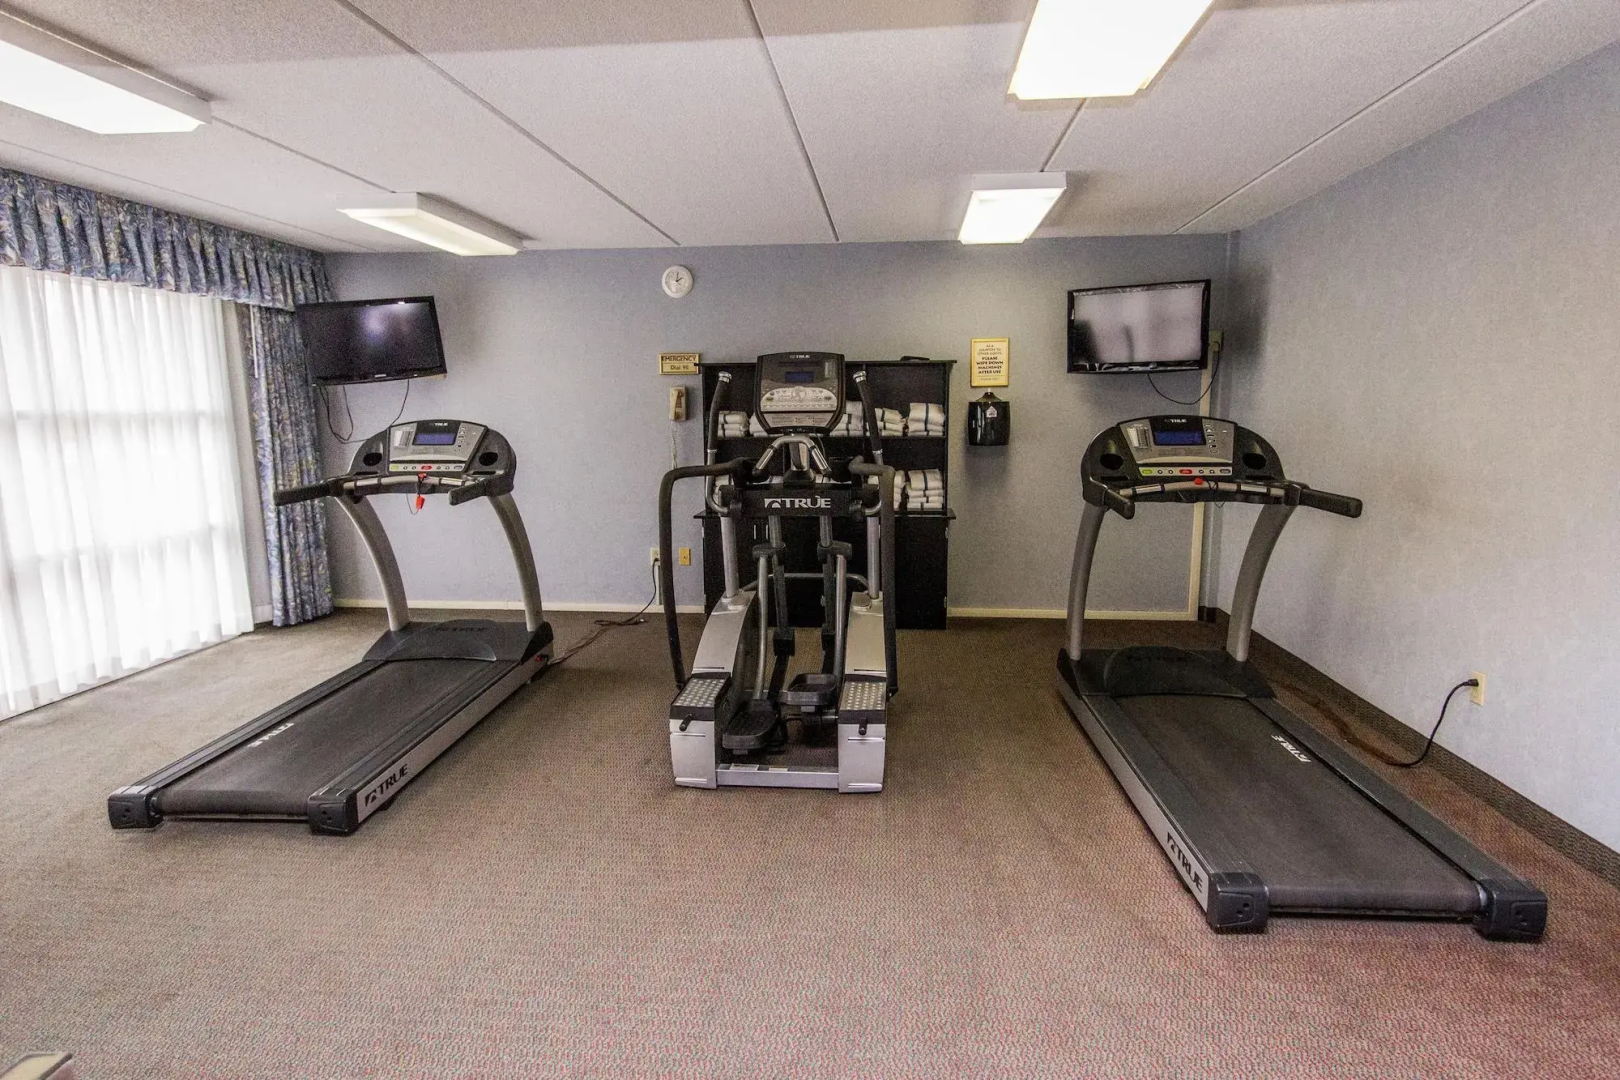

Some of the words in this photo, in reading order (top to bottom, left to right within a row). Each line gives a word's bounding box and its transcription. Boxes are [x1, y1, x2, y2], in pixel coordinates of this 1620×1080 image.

[781, 497, 831, 508] TRUE
[377, 763, 408, 795] TRUE
[1176, 844, 1203, 893] TRUE
